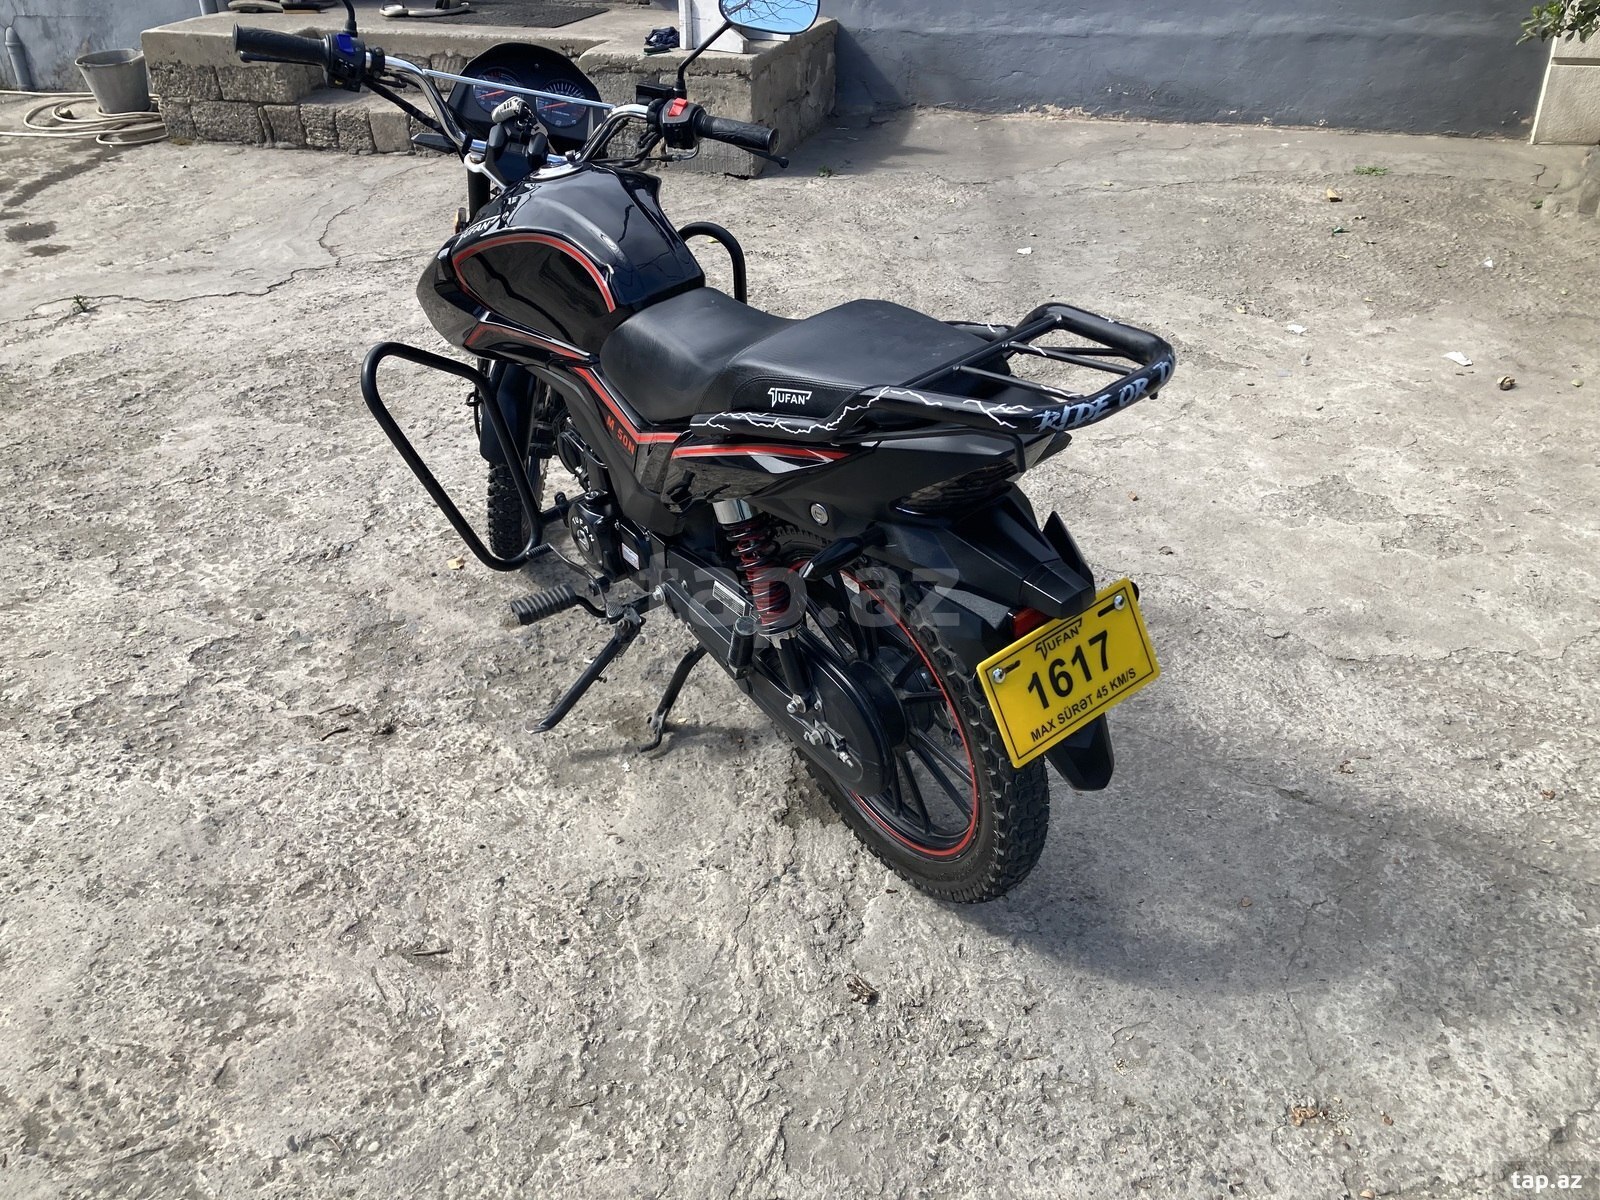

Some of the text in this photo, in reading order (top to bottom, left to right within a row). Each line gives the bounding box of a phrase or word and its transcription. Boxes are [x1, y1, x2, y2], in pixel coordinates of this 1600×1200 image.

[767, 387, 813, 408] TUFAN
[1032, 394, 1112, 432] RIDE
[1118, 377, 1149, 407] OR
[606, 415, 615, 431] M
[1035, 617, 1083, 661] TUFAN
[1027, 629, 1109, 710] 1617
[1031, 667, 1137, 742] MAX SÜRƏT 45 KM/S
